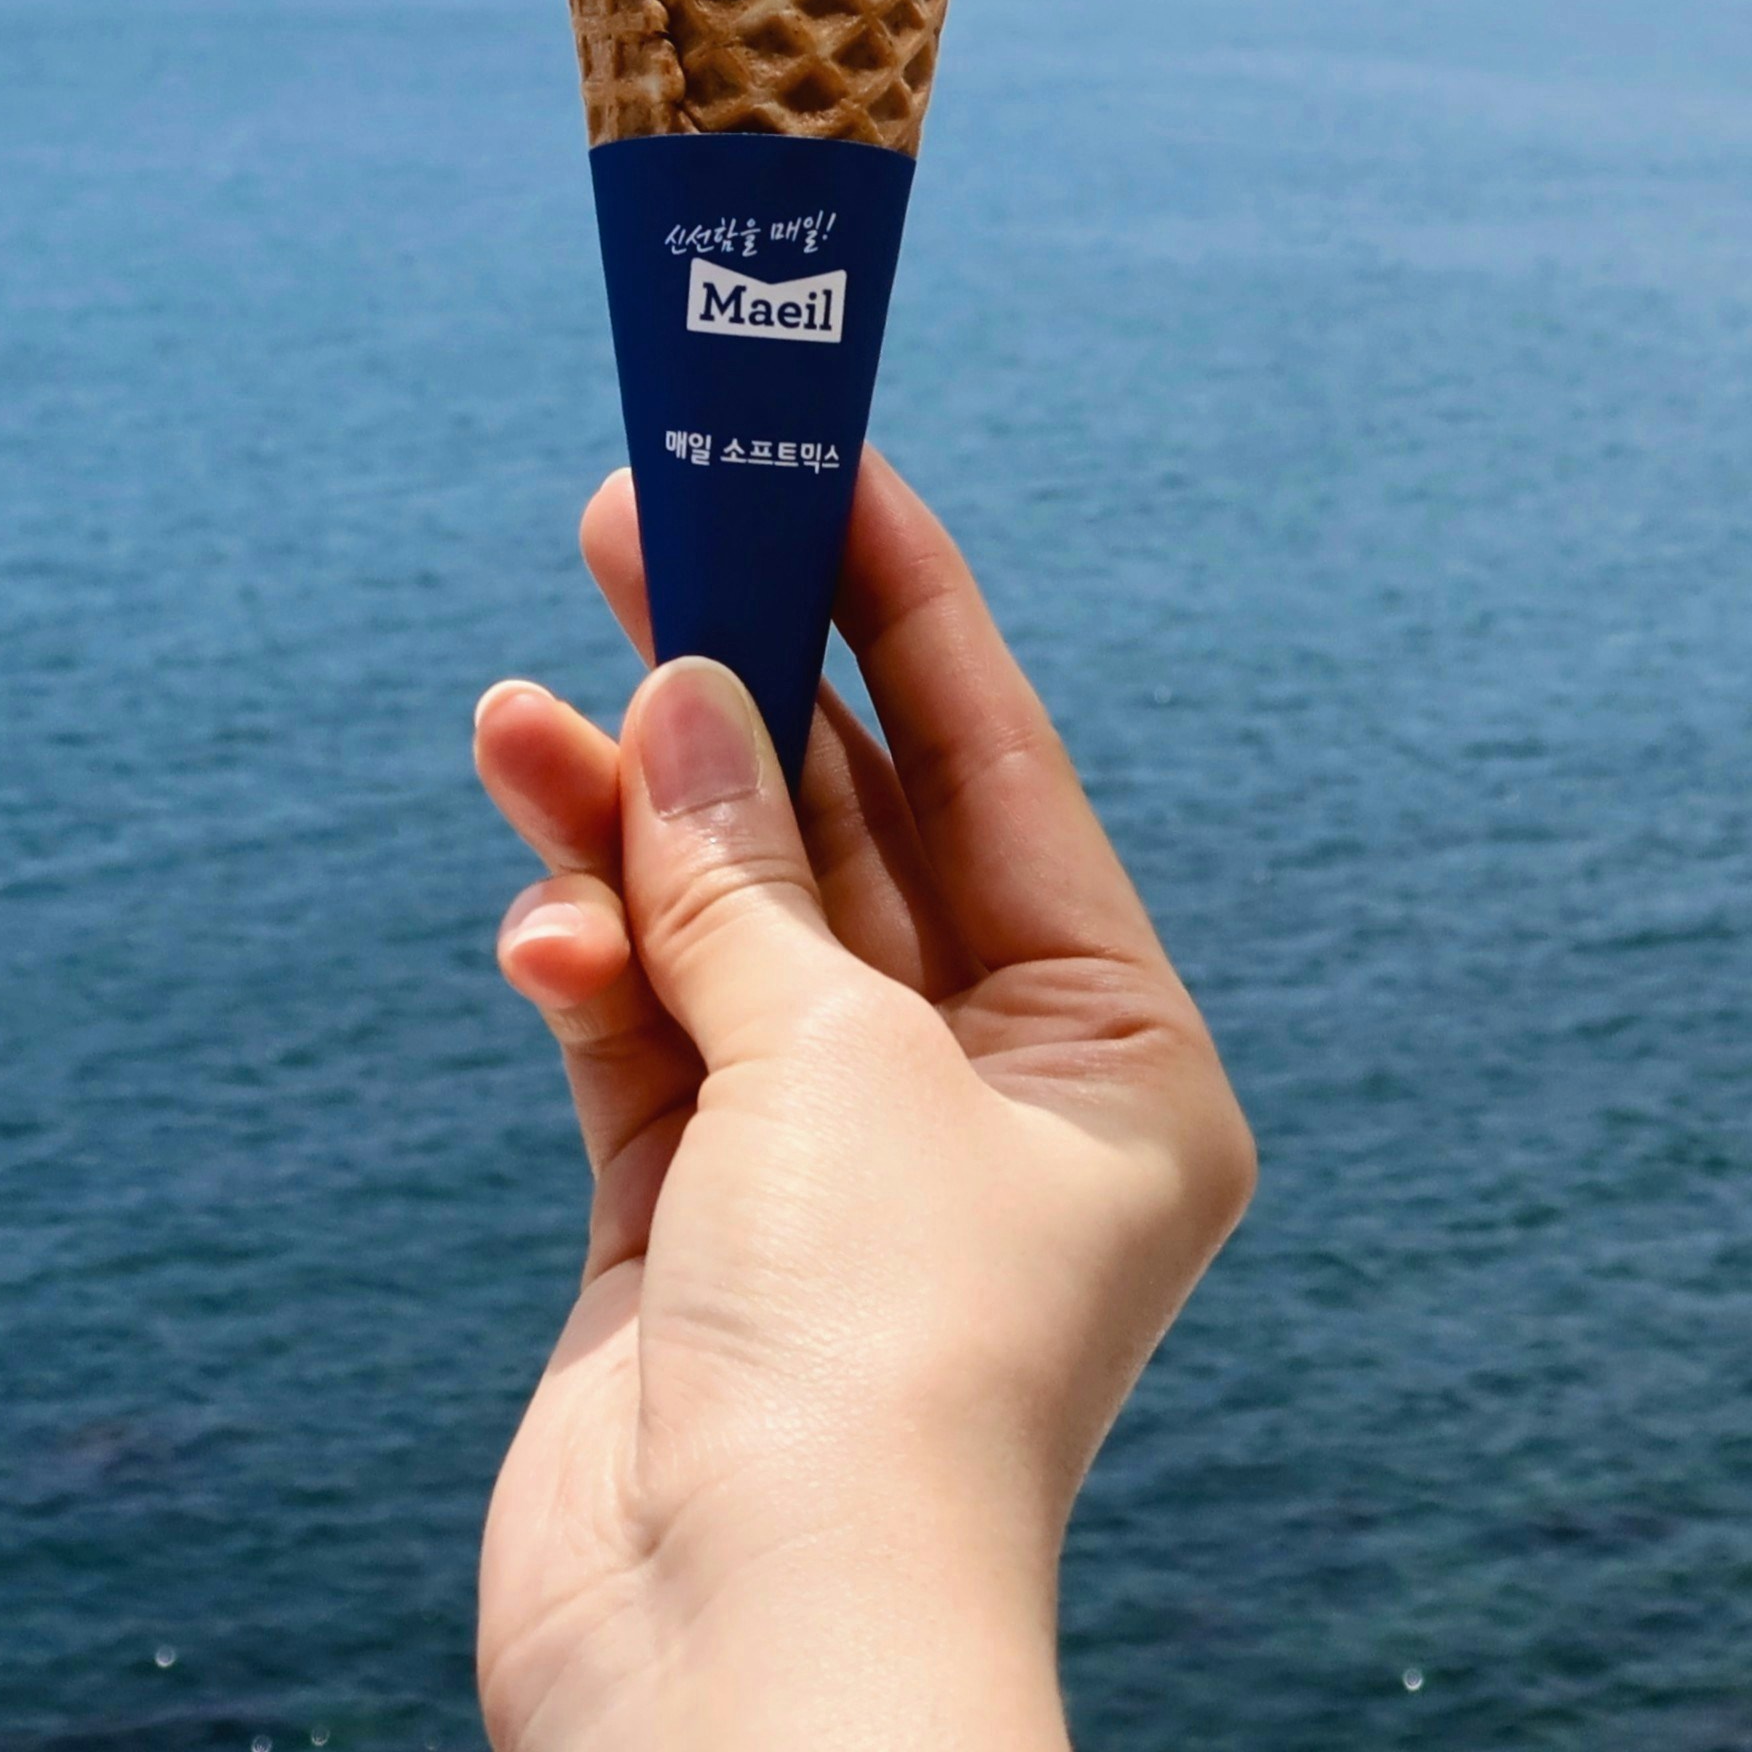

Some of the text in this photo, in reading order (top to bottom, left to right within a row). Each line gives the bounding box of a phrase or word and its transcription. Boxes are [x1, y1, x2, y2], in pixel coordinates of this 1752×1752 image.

[664, 210, 836, 257] 신선함을 매일!
[699, 282, 833, 331] Maeil
[665, 430, 840, 475] 매일 소프트믹스
